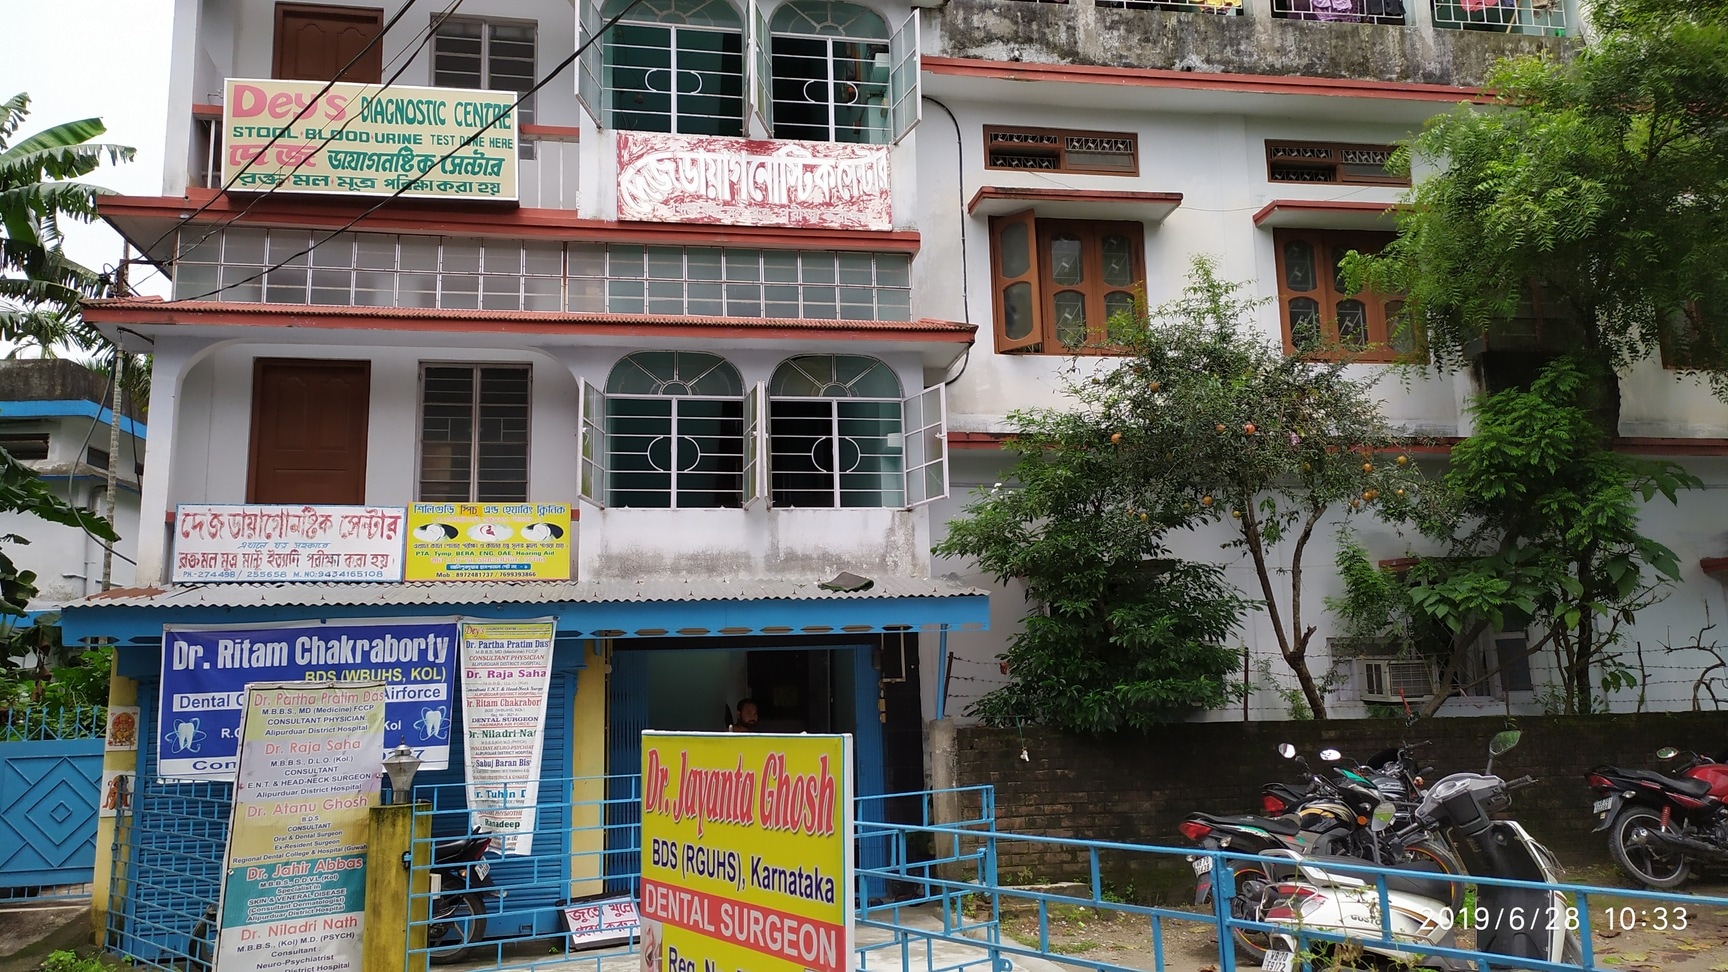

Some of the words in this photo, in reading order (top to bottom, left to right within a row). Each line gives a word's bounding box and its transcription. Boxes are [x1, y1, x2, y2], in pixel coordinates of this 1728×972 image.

[232, 84, 348, 121] Dey's
[361, 96, 446, 126] DIAGNOSTIC
[455, 101, 511, 130] CENTRE
[233, 126, 298, 138] STOOL
[305, 128, 370, 142] BLOOD
[375, 132, 423, 145] URINE
[430, 134, 455, 146] TEST
[459, 135, 485, 148] DONE
[489, 137, 513, 149] HERE
[440, 149, 505, 177] সেন্টার
[292, 174, 330, 187] মল
[336, 176, 378, 191] মূত্র
[436, 180, 475, 194] করা
[477, 181, 501, 196] হয়
[200, 552, 219, 568] মল
[344, 553, 368, 568] করা
[172, 640, 211, 671] Dr.
[217, 639, 289, 669] Ritam
[295, 633, 449, 666] Chakraborty
[466, 641, 476, 649] Dr.
[478, 641, 505, 649] Partha
[507, 640, 533, 649] Pratim
[535, 640, 549, 648] Das
[305, 670, 337, 681] BDS
[341, 668, 407, 683] (WBUHS,
[411, 666, 446, 682] KOL)
[466, 670, 482, 679] Dr.
[487, 670, 514, 680] Raja
[518, 669, 547, 678] Saha
[180, 694, 230, 709] Dental
[254, 694, 271, 707] Dr.
[276, 692, 317, 706] Partha
[321, 692, 359, 704] Pratim
[363, 691, 384, 702] Das
[476, 699, 498, 707] Ritam
[313, 705, 352, 714] (Medicine)
[353, 704, 375, 712] FCCP
[267, 717, 320, 726] CONSULTANT
[265, 729, 306, 737] Alipurduar
[308, 726, 335, 734] District
[338, 725, 368, 733] Hospital
[482, 729, 517, 738] Niladri
[265, 743, 284, 755] Dr.
[290, 742, 321, 756] Raja
[327, 739, 361, 751] Saha
[284, 766, 339, 776] CONSULTANT
[475, 759, 494, 769] Sabuj
[495, 759, 517, 767] Baran
[281, 776, 329, 786] HEAD-NECK
[332, 773, 371, 782] SURGEON
[256, 789, 298, 799] Alipurduar
[300, 787, 329, 795] District
[331, 783, 362, 793] Hospital
[645, 748, 670, 814] Dr.
[672, 751, 755, 839] Jayanta
[759, 752, 836, 837] Ghosh
[247, 806, 267, 818] Dr.
[273, 802, 317, 815] Atanu
[323, 796, 368, 811] Ghosh
[287, 822, 332, 832] CONSULTANT
[273, 834, 287, 842] Oral
[295, 832, 316, 840] Dental
[317, 830, 343, 839] Surgeon
[274, 841, 313, 851] Ex-Resident
[314, 838, 340, 848] Surgeon
[232, 855, 261, 864] Regional
[263, 853, 284, 861] Dental
[285, 850, 310, 859] College
[317, 846, 344, 855] Hospital
[247, 868, 268, 880] Dr.
[273, 861, 311, 878] Jahir
[315, 857, 363, 872] Abbas
[652, 838, 677, 870] BDS
[681, 843, 745, 891] (RGUHS),
[751, 855, 835, 904] Karnataka
[248, 898, 267, 906] SKIN
[276, 892, 312, 901] VENERAL
[314, 888, 347, 897] DISEASE
[276, 885, 312, 894] Specialist
[248, 903, 291, 915] (Consultant
[292, 897, 345, 907] Dermatologist)
[288, 908, 314, 917] District
[315, 905, 345, 914] Hospital
[240, 929, 261, 941] Dr.
[268, 920, 317, 937] Niladri
[323, 916, 358, 931] Nath
[645, 883, 715, 932] DENTAL
[720, 903, 837, 968] SURGEON
[278, 939, 298, 948] (Kol)
[300, 936, 317, 944] M.D.
[320, 932, 355, 942] (PSYCH)
[271, 947, 317, 958] Consultant
[256, 955, 334, 969] Neuro-Psychiatrist
[316, 962, 350, 972] Hospital
